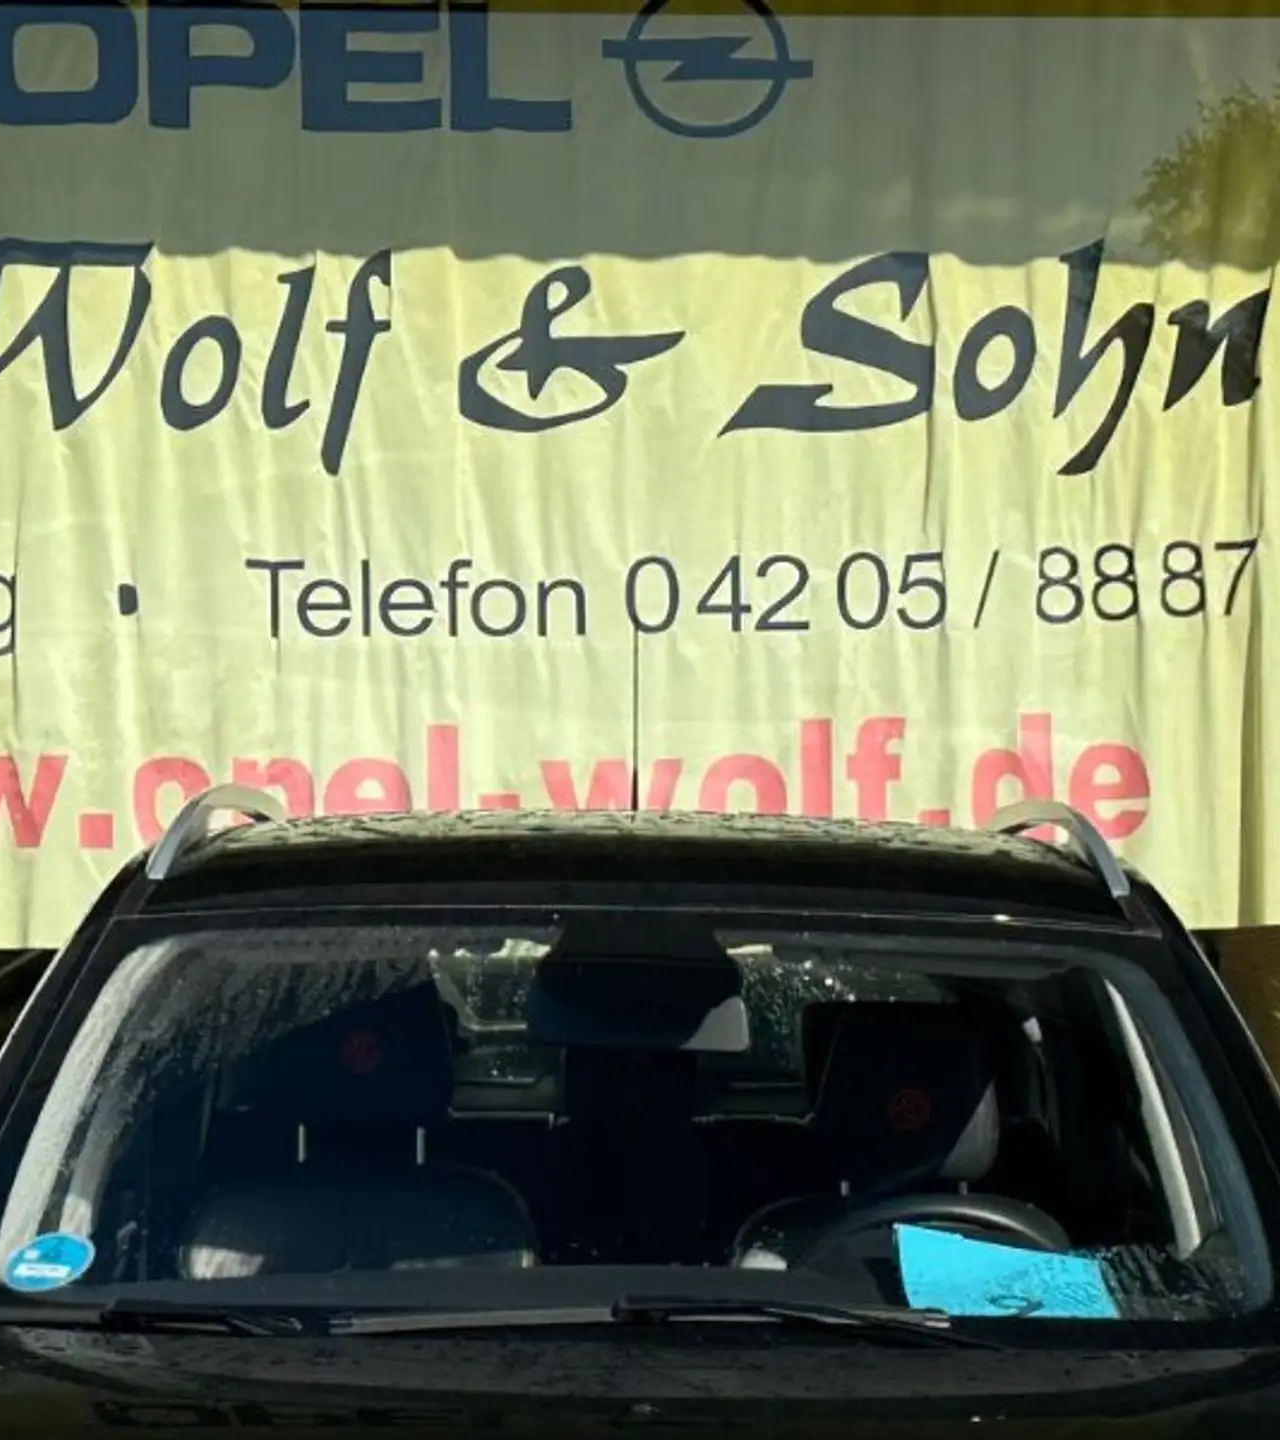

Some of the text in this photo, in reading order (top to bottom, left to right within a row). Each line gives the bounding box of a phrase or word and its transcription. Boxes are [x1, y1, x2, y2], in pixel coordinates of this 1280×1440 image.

[457, 265, 687, 433] &
[717, 238, 1273, 477] Sohn
[245, 557, 588, 638] Telefon
